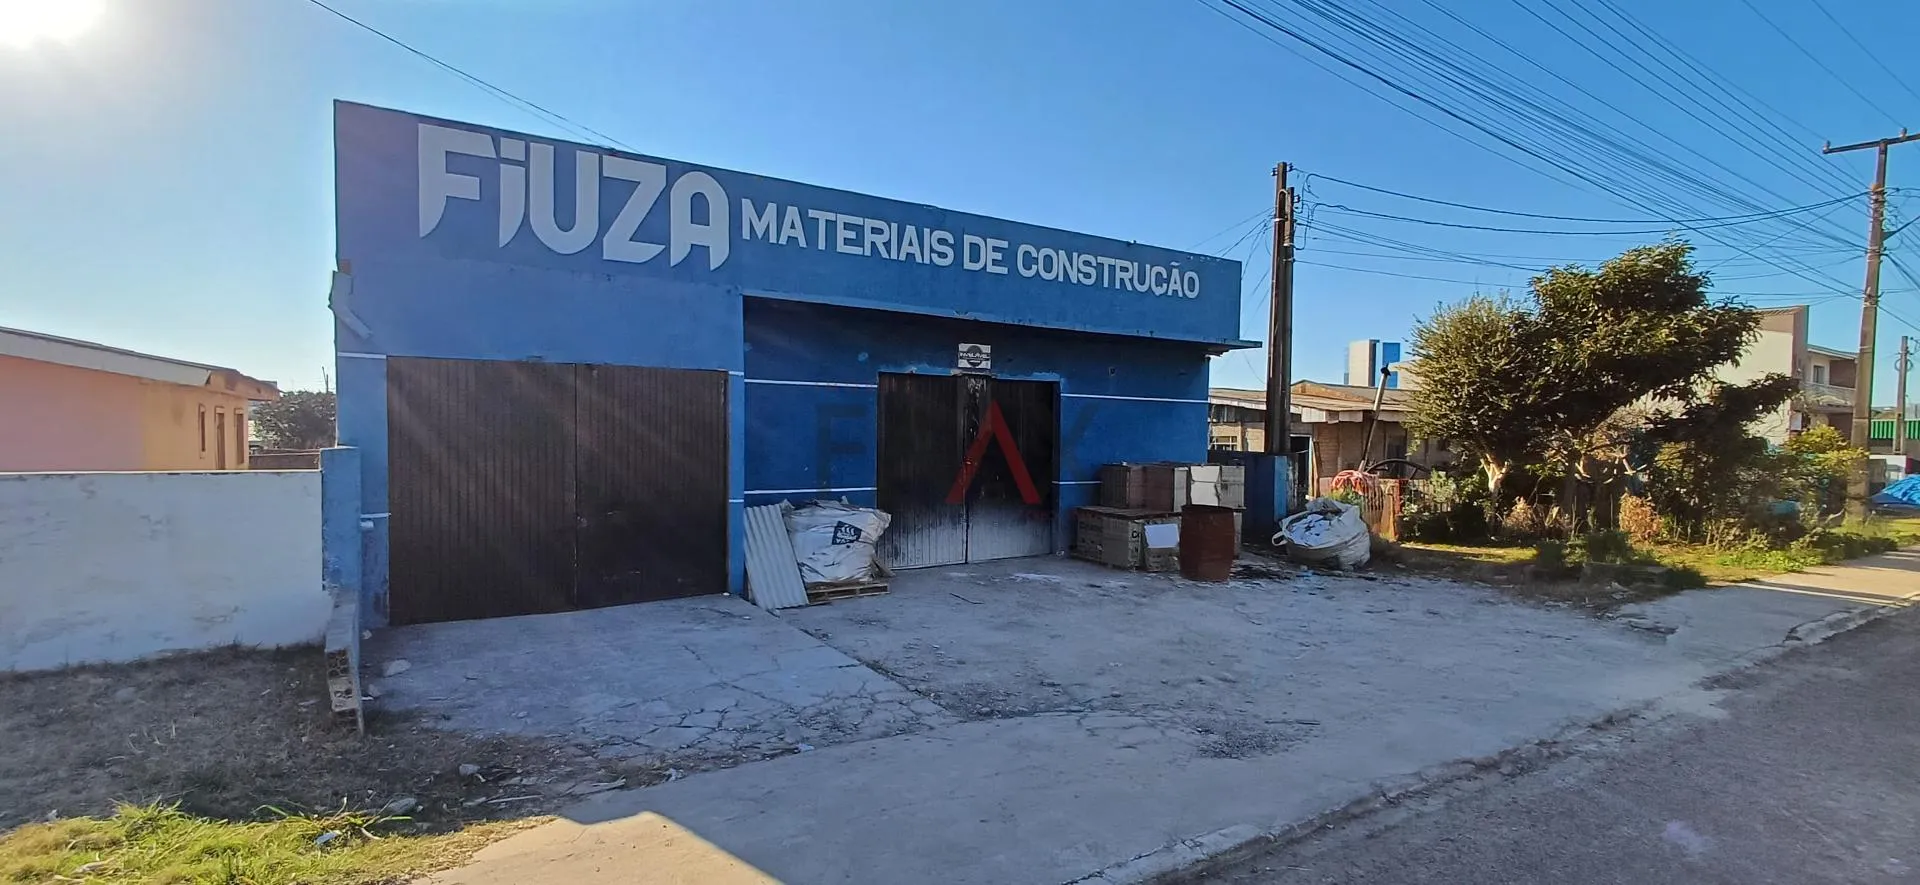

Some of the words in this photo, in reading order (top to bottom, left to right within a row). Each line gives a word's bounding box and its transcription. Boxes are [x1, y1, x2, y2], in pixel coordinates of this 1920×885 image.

[741, 198, 955, 267] MATERIAIS
[962, 233, 1010, 276] DE
[1016, 244, 1200, 300] CONSTRUÇÃO
